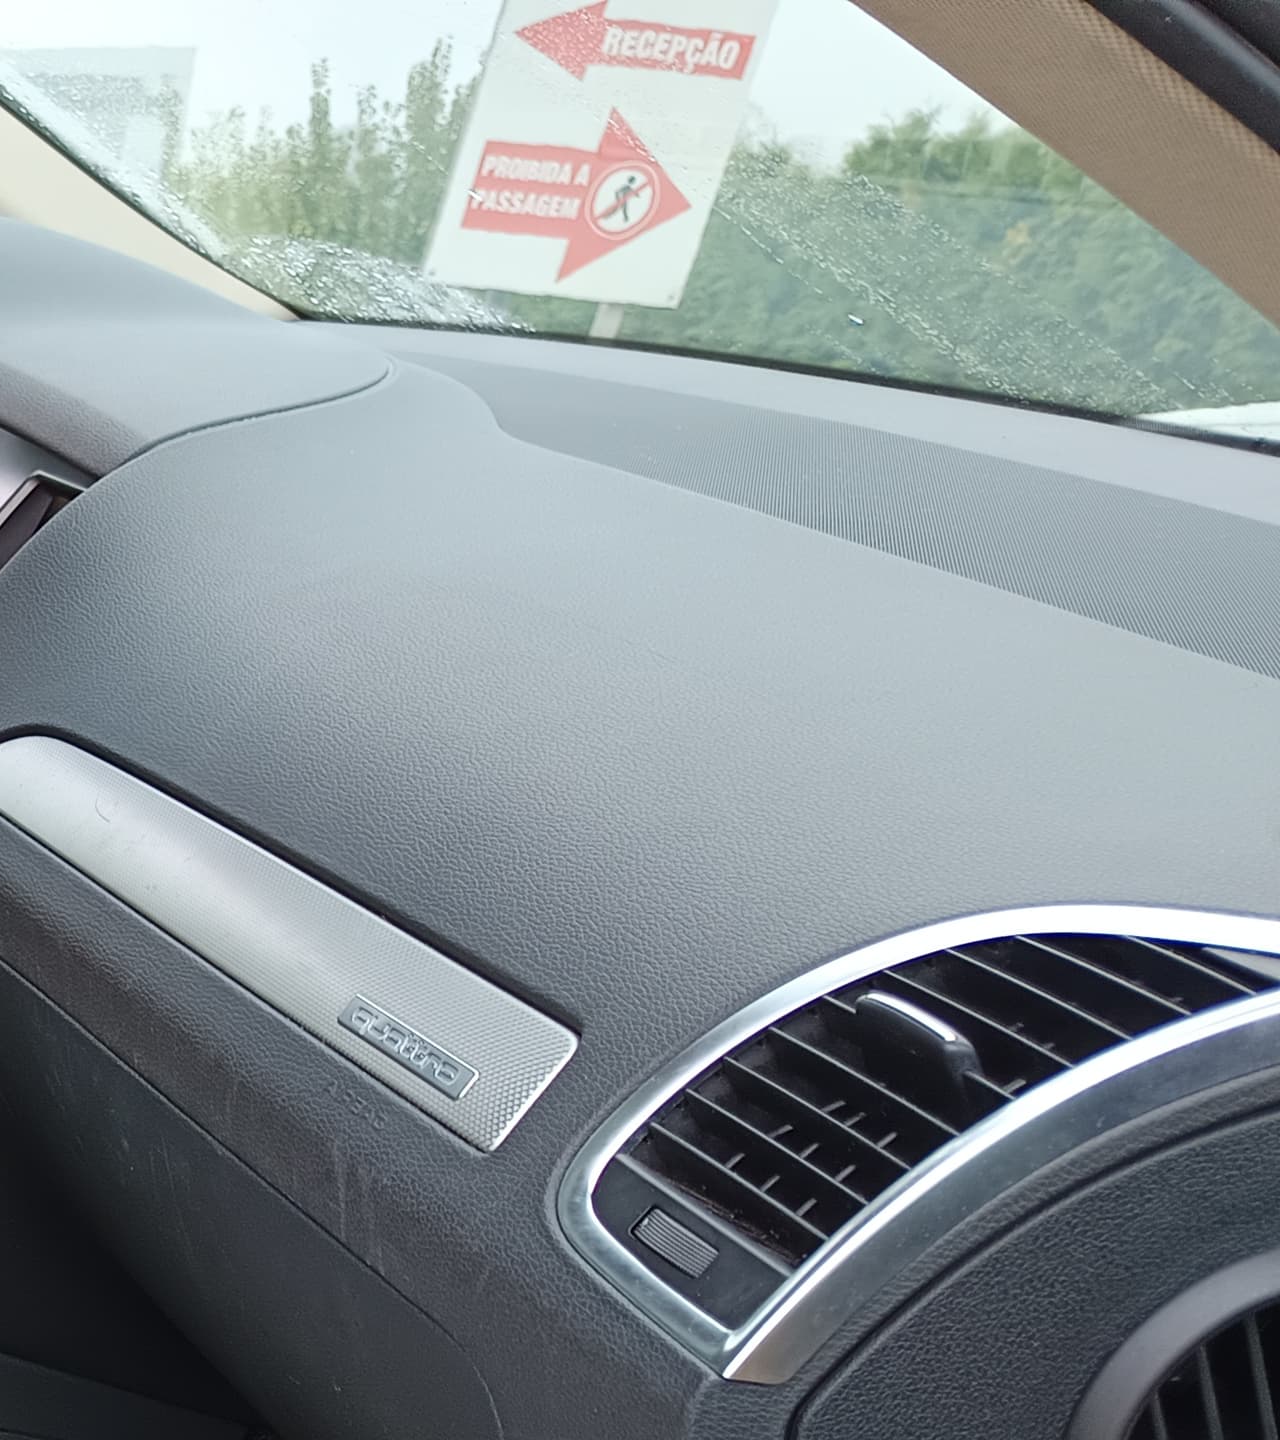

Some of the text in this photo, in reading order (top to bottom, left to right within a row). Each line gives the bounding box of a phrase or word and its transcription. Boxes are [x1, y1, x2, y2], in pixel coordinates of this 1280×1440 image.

[603, 25, 739, 74] RECEPÇÃO
[481, 155, 590, 186] PROIBIDA A
[471, 187, 580, 220] PASSAGEM
[350, 1005, 460, 1086] quattro
